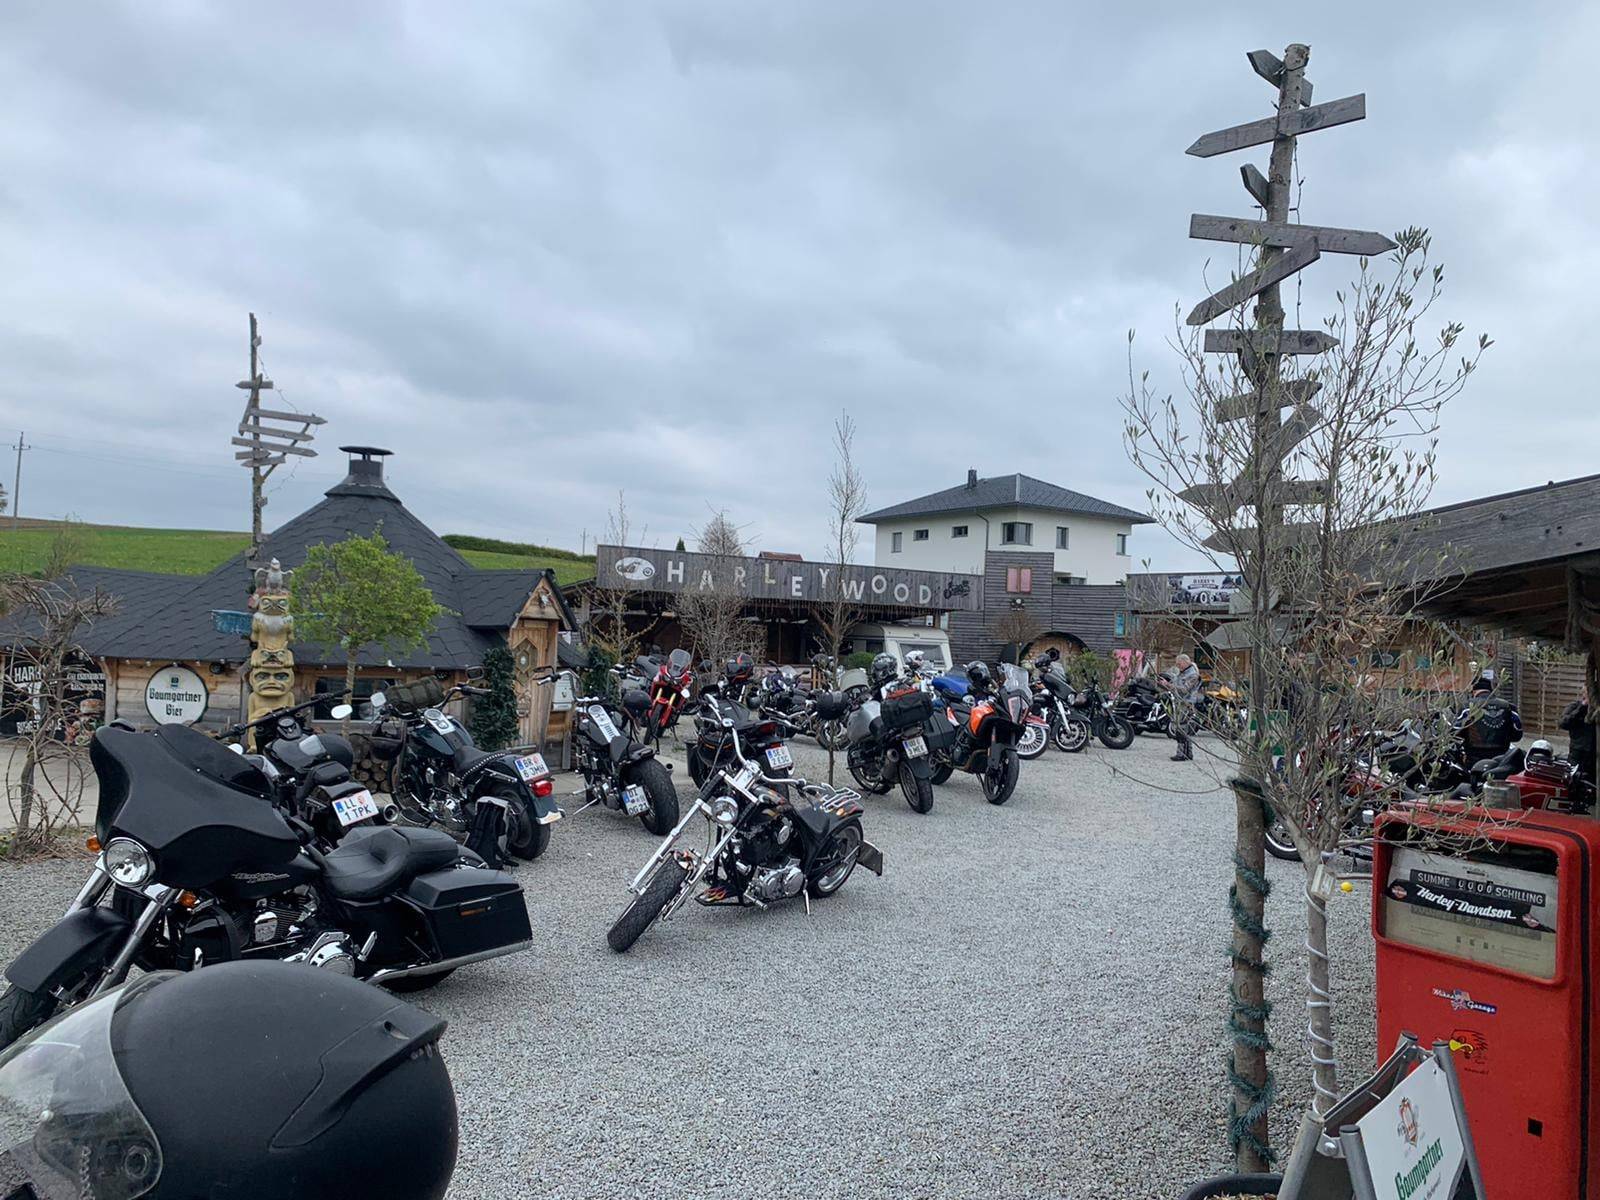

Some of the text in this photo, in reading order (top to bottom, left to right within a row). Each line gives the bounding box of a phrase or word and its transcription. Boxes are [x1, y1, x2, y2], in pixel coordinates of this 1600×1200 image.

[667, 561, 932, 604] HARLEYWOOD
[149, 688, 202, 702] Baumgartner
[166, 704, 183, 716] Bier
[344, 799, 357, 809] LL
[345, 804, 372, 820] 1 TPK
[1418, 873, 1450, 887] SUMME
[1495, 887, 1544, 905] SCHILLING
[1416, 884, 1517, 919] Harley-Davidson
[1395, 1137, 1444, 1200] Baumgartner
